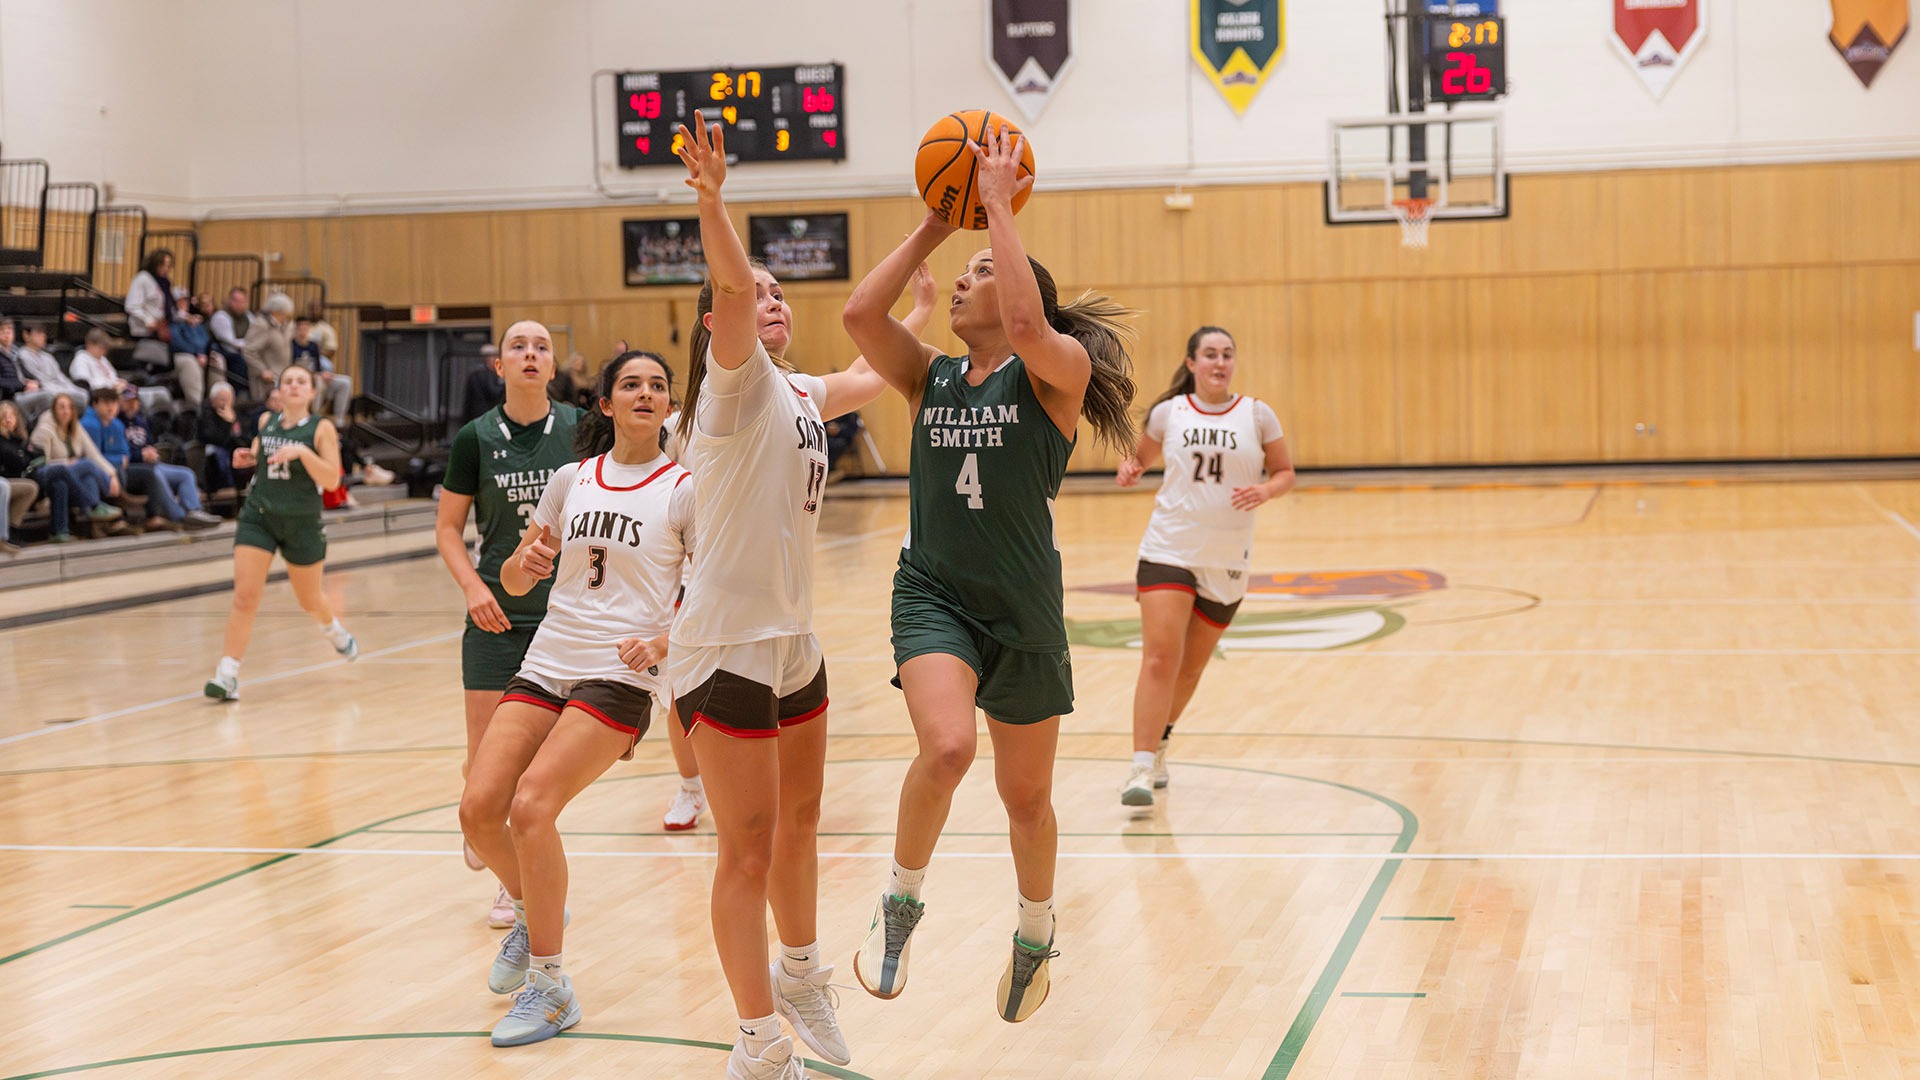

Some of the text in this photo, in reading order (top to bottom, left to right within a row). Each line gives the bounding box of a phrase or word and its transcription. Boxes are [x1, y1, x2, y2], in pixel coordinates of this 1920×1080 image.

[1448, 21, 1499, 48] 2:17
[710, 71, 761, 101] 2:17
[1442, 51, 1492, 95] 26
[630, 91, 661, 119] 43
[803, 86, 835, 113] 66
[923, 404, 1019, 426] WILLIAM
[930, 427, 1004, 448] SMITH
[1183, 428, 1237, 450] SAINTS
[494, 468, 555, 489] WILLIA
[955, 453, 984, 510] 4
[1192, 451, 1224, 485] 24
[567, 510, 643, 548] SAINTS
[588, 545, 607, 590] 3
